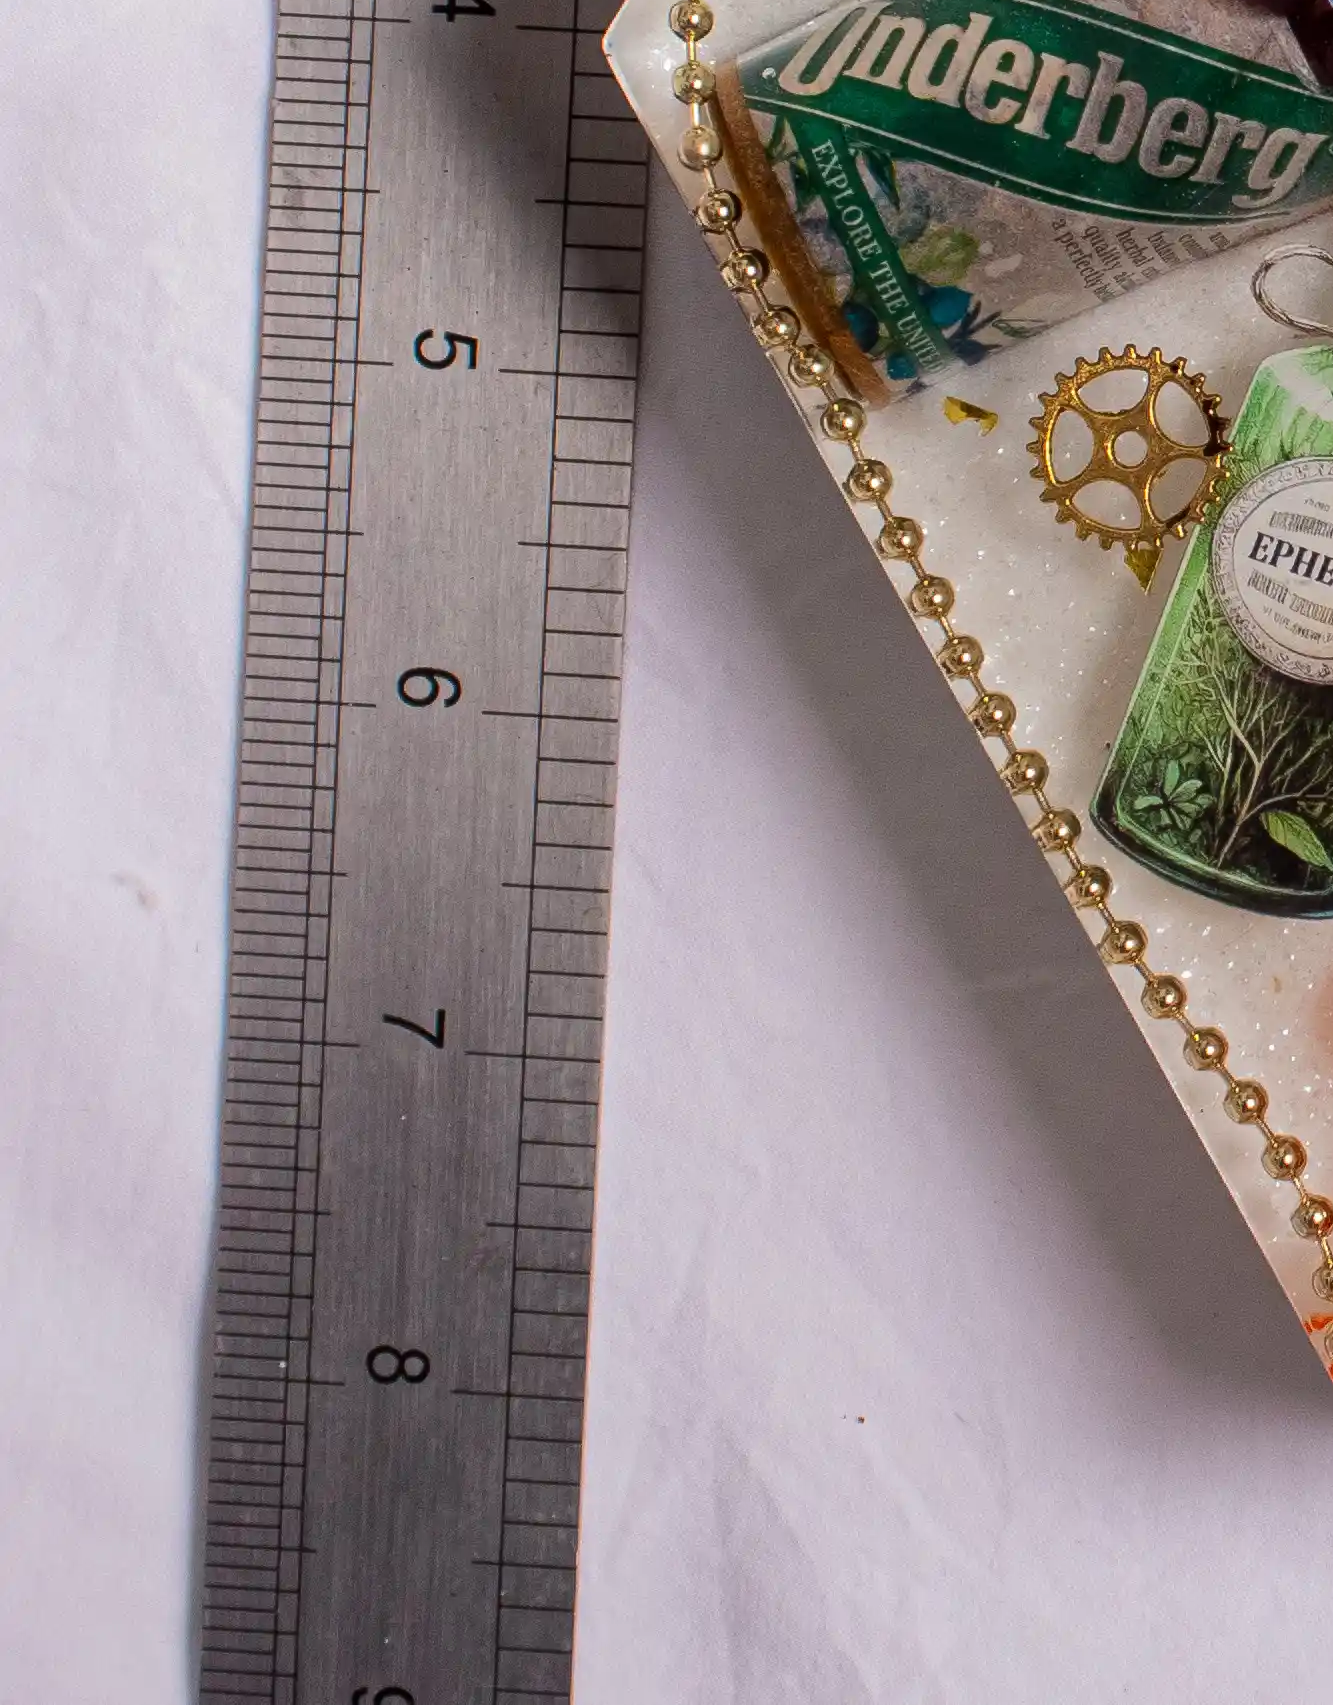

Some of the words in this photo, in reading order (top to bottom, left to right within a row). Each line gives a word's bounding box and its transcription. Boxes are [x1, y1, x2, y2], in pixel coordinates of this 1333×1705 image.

[779, 0, 1329, 209] Underberg
[811, 138, 884, 263] EXPLORE
[868, 257, 909, 315] THE
[414, 329, 478, 370] 5
[397, 665, 463, 709] 6
[382, 1009, 446, 1049] 7
[365, 1344, 431, 1385] 8
